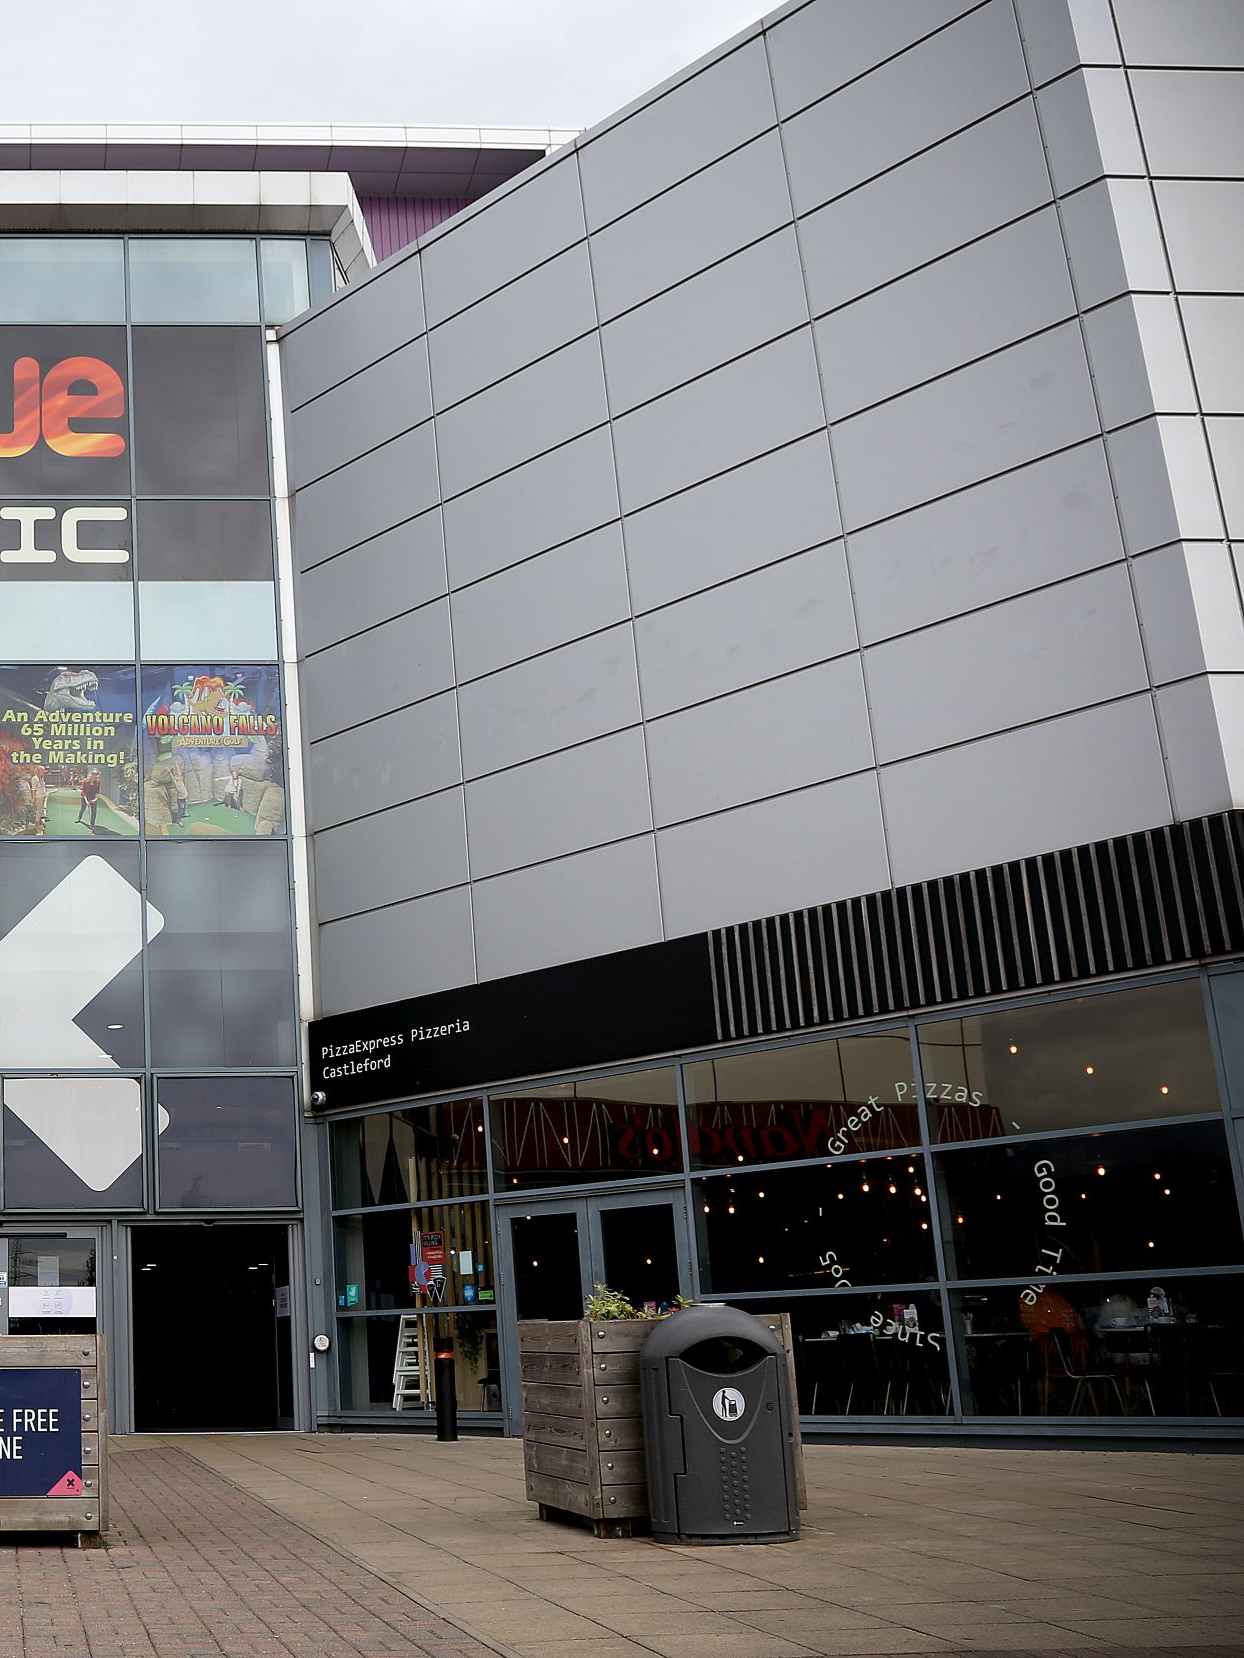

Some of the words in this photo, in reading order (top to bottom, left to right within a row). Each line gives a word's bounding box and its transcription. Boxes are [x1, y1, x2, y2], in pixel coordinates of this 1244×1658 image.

[1, 709, 28, 722] An
[34, 709, 134, 723] Adventure
[145, 713, 224, 736] VOLCANO
[229, 713, 278, 736] FALLS
[21, 723, 44, 736] 65
[50, 723, 115, 737] Million
[31, 737, 81, 750] Years
[86, 737, 105, 750] in
[11, 751, 43, 764] the
[48, 751, 125, 768] Making!
[321, 1033, 404, 1060] PizzaExpress
[410, 1019, 470, 1042] Pizzeria
[322, 1054, 391, 1080] Castleford
[827, 1095, 885, 1155] Great
[1033, 1159, 1067, 1227] Good
[12, 1408, 60, 1432] FREE
